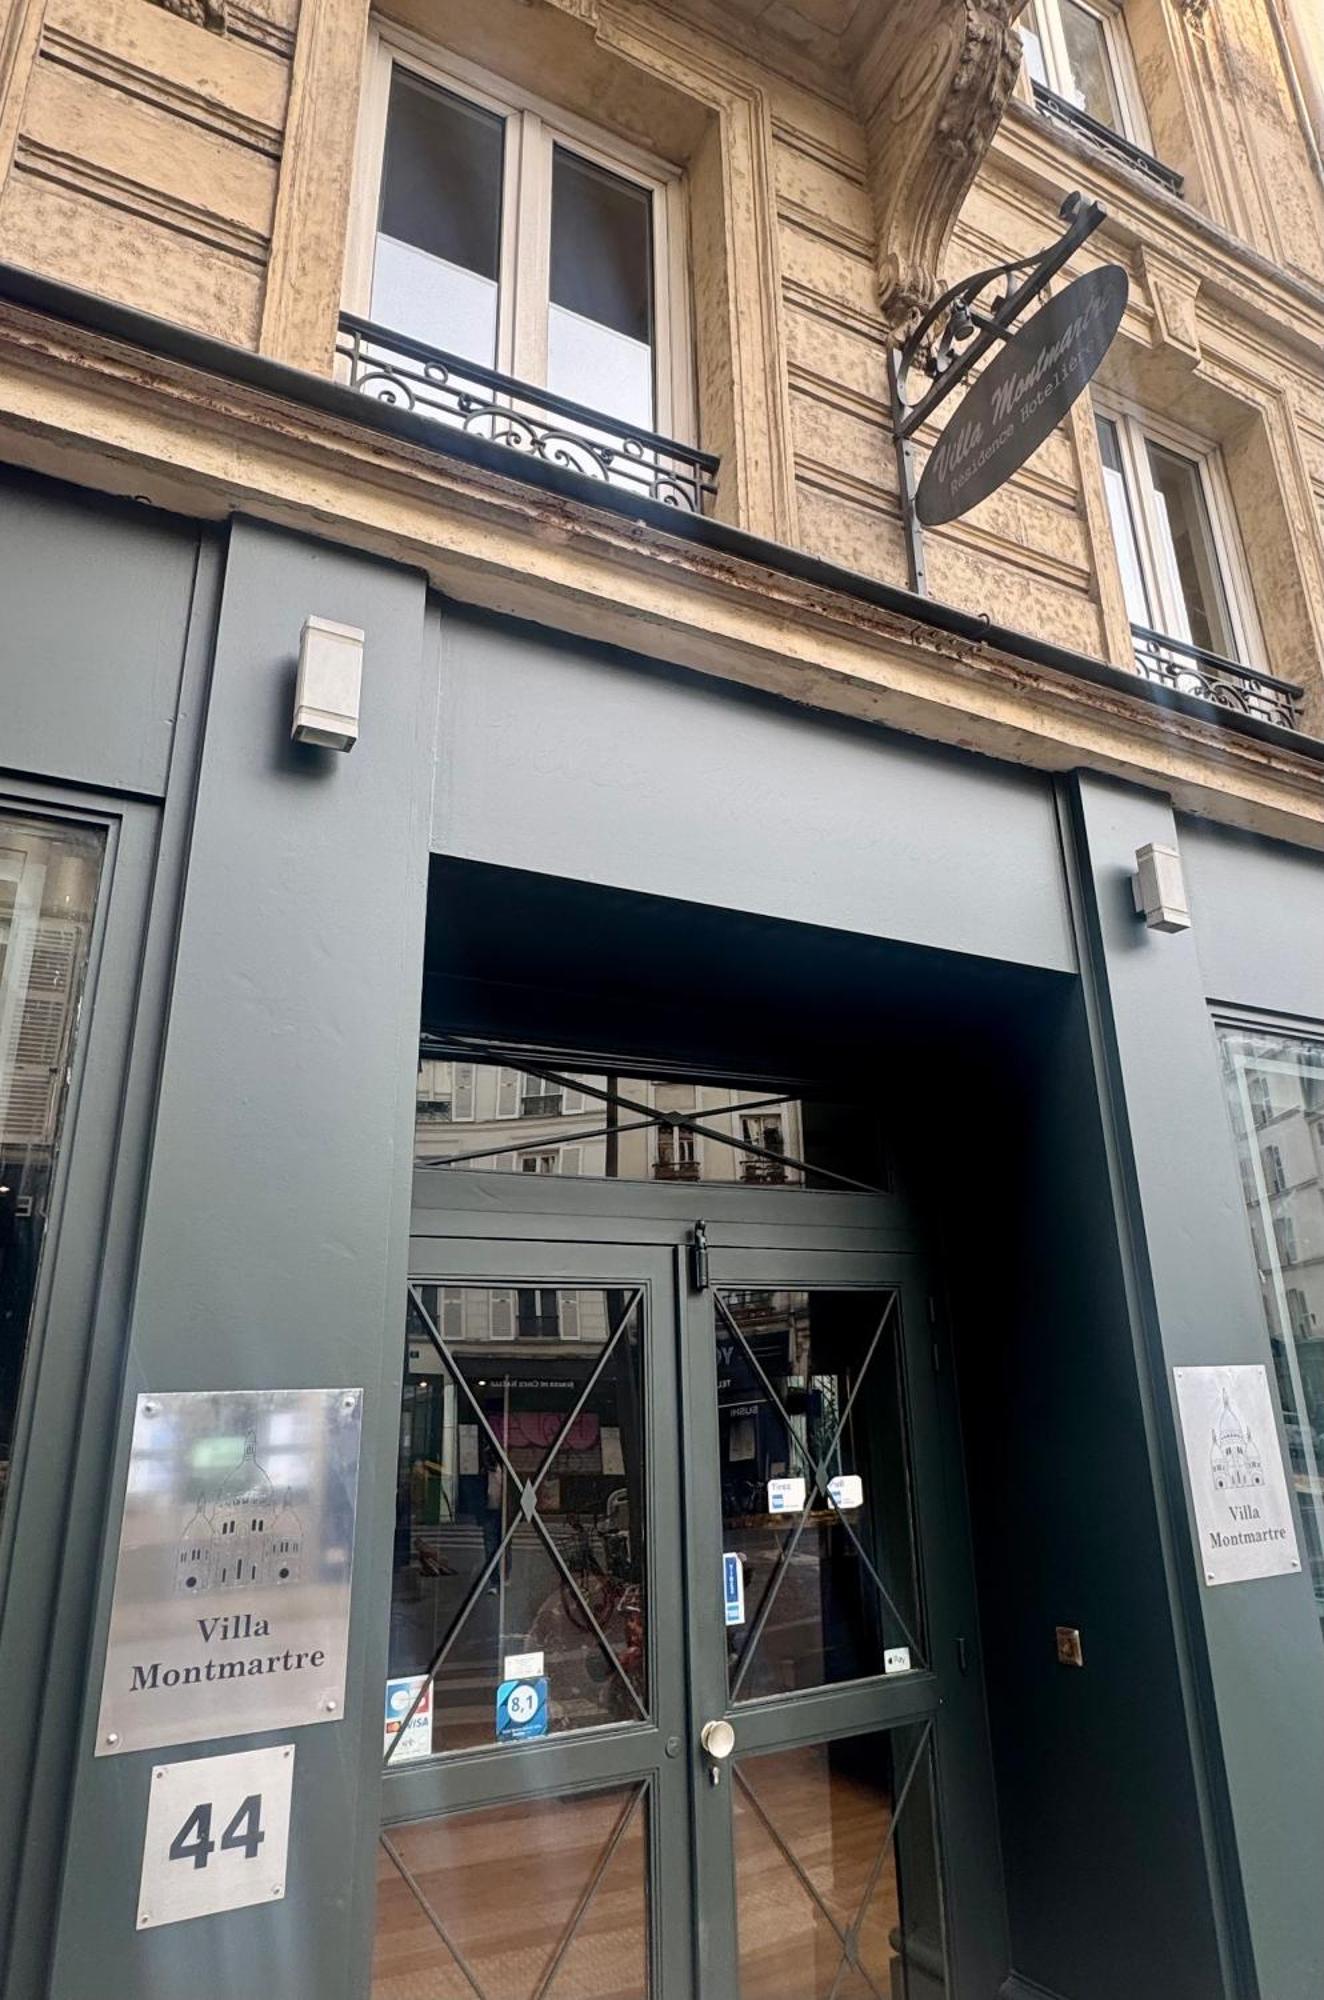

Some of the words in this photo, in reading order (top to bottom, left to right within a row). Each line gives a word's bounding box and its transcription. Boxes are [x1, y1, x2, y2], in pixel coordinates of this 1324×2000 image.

[932, 421, 984, 483] Villa
[1229, 1505, 1260, 1522] Villa
[1209, 1527, 1287, 1549] Montmartre
[196, 1613, 270, 1643] Villa
[129, 1648, 326, 1692] Montmartre
[511, 1695, 533, 1713] 8,1
[169, 1794, 265, 1870] 44
